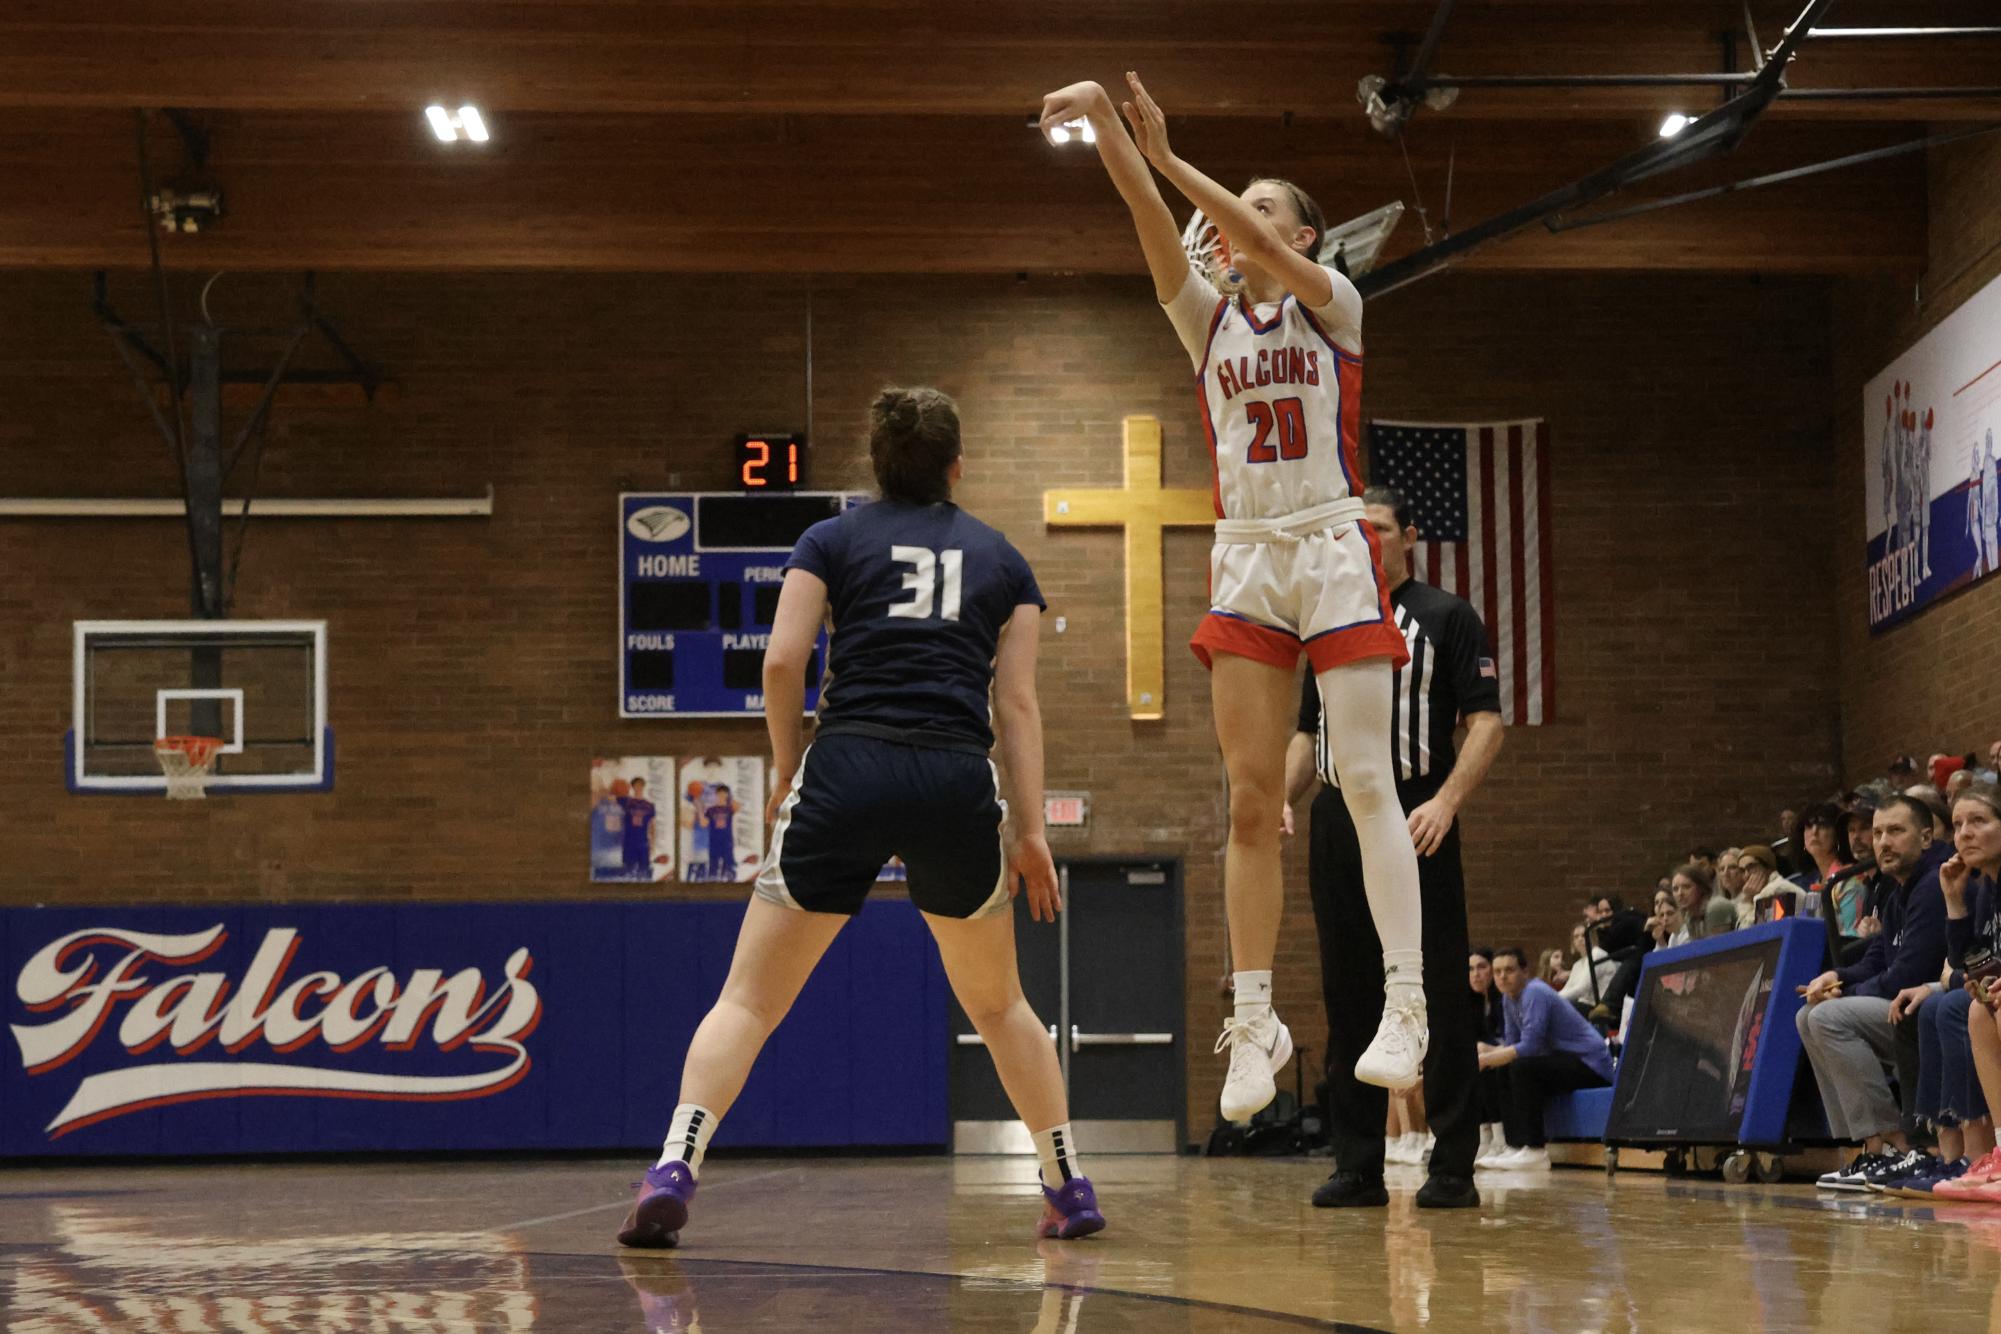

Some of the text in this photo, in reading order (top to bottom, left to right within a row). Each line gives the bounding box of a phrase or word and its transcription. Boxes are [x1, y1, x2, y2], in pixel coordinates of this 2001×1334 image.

[1245, 397, 1308, 463] 20
[742, 441, 797, 486] 21
[638, 555, 700, 577] HOME
[744, 566, 785, 582] PERIO
[888, 545, 963, 622] 31
[1869, 541, 1915, 626] RESPECT
[628, 634, 675, 650] FOULS
[722, 634, 770, 650] PLAYE
[628, 695, 675, 711] SCORE
[10, 922, 541, 1078] Falcons
